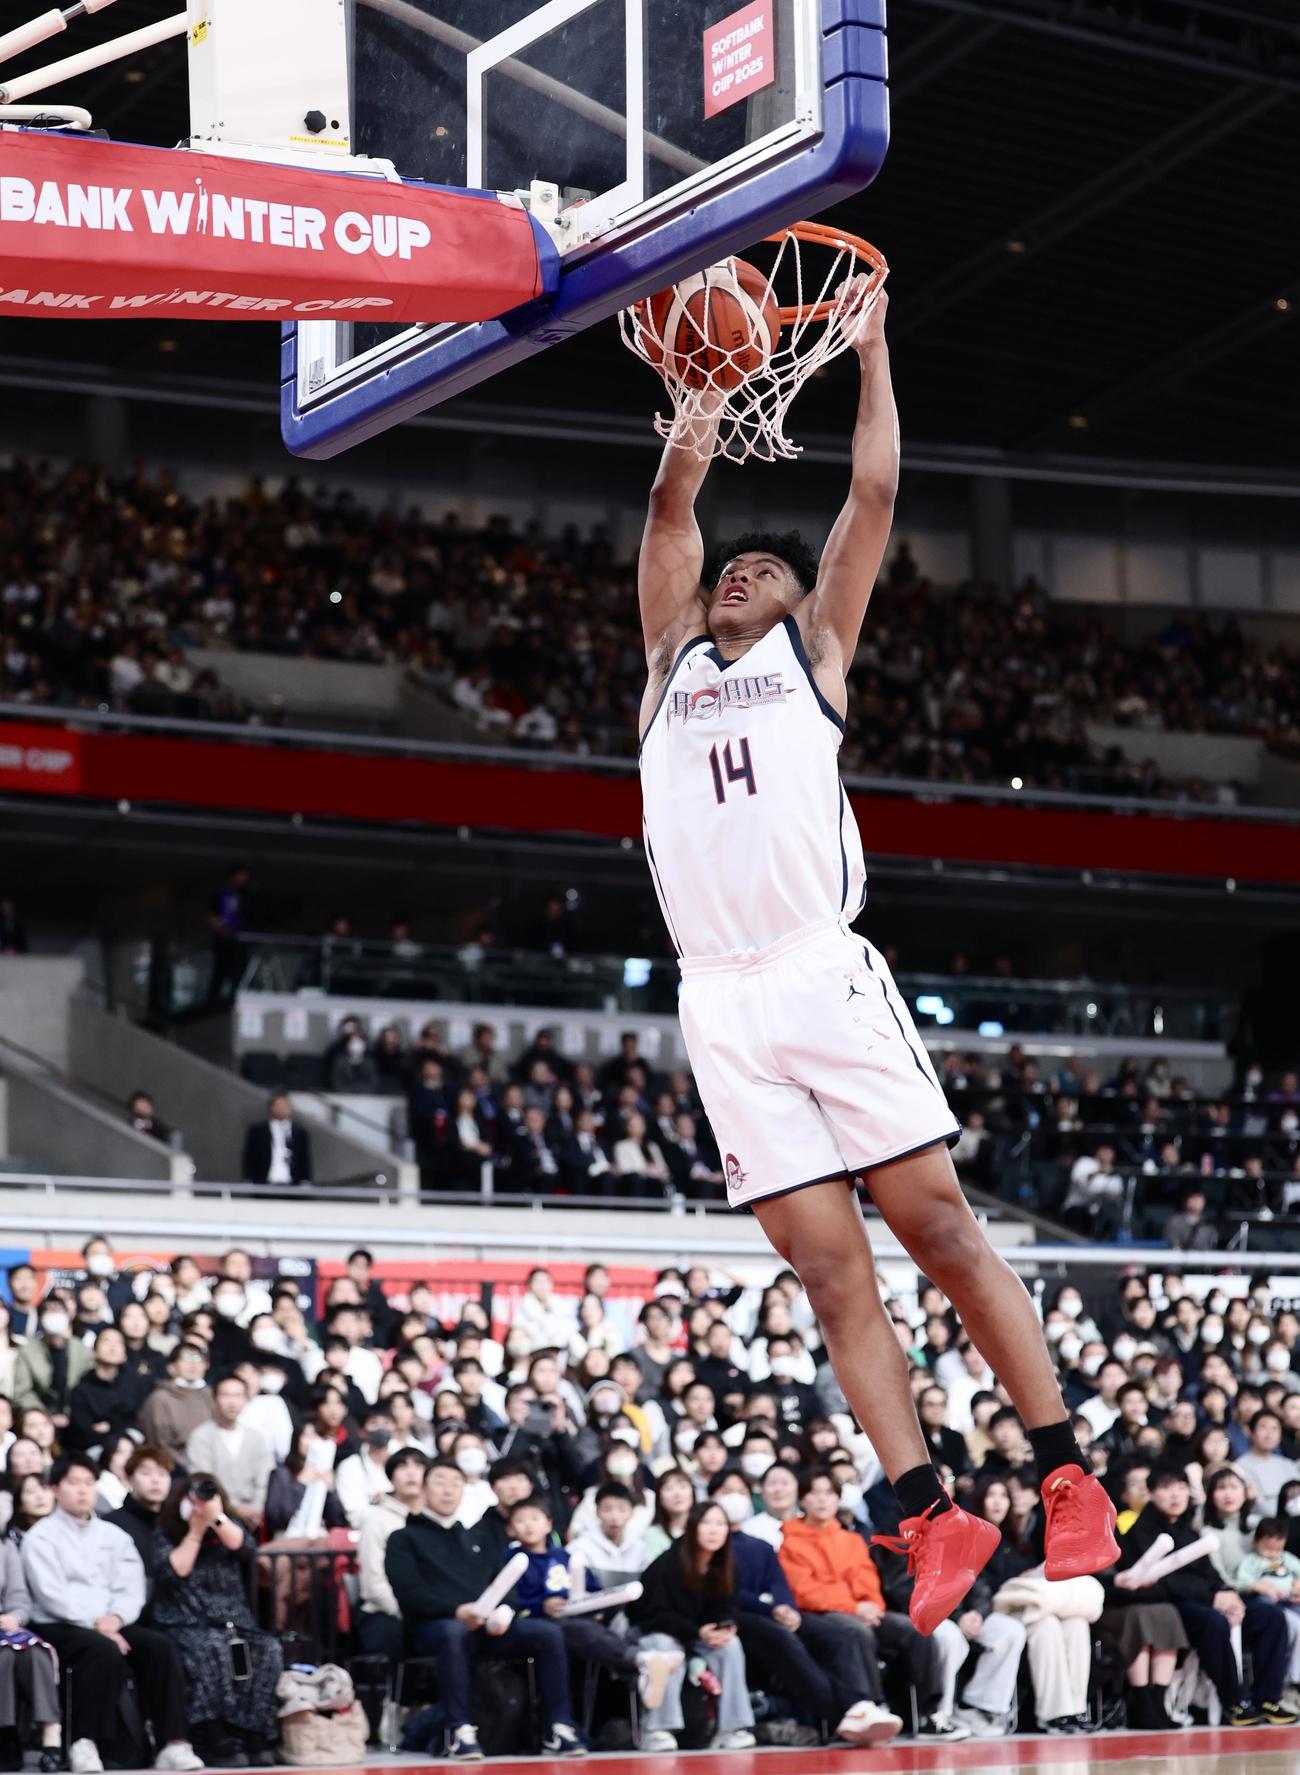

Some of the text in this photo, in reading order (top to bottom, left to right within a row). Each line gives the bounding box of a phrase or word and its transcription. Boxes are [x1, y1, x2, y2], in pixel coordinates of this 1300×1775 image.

[712, 15, 764, 58] SOFTBANK
[712, 42, 752, 76] WINTER
[712, 55, 764, 97] CUP 2025
[0, 176, 431, 260] BANK WINTER CUP
[0, 286, 394, 312] ANK WINTER CUP
[709, 736, 758, 805] 14
